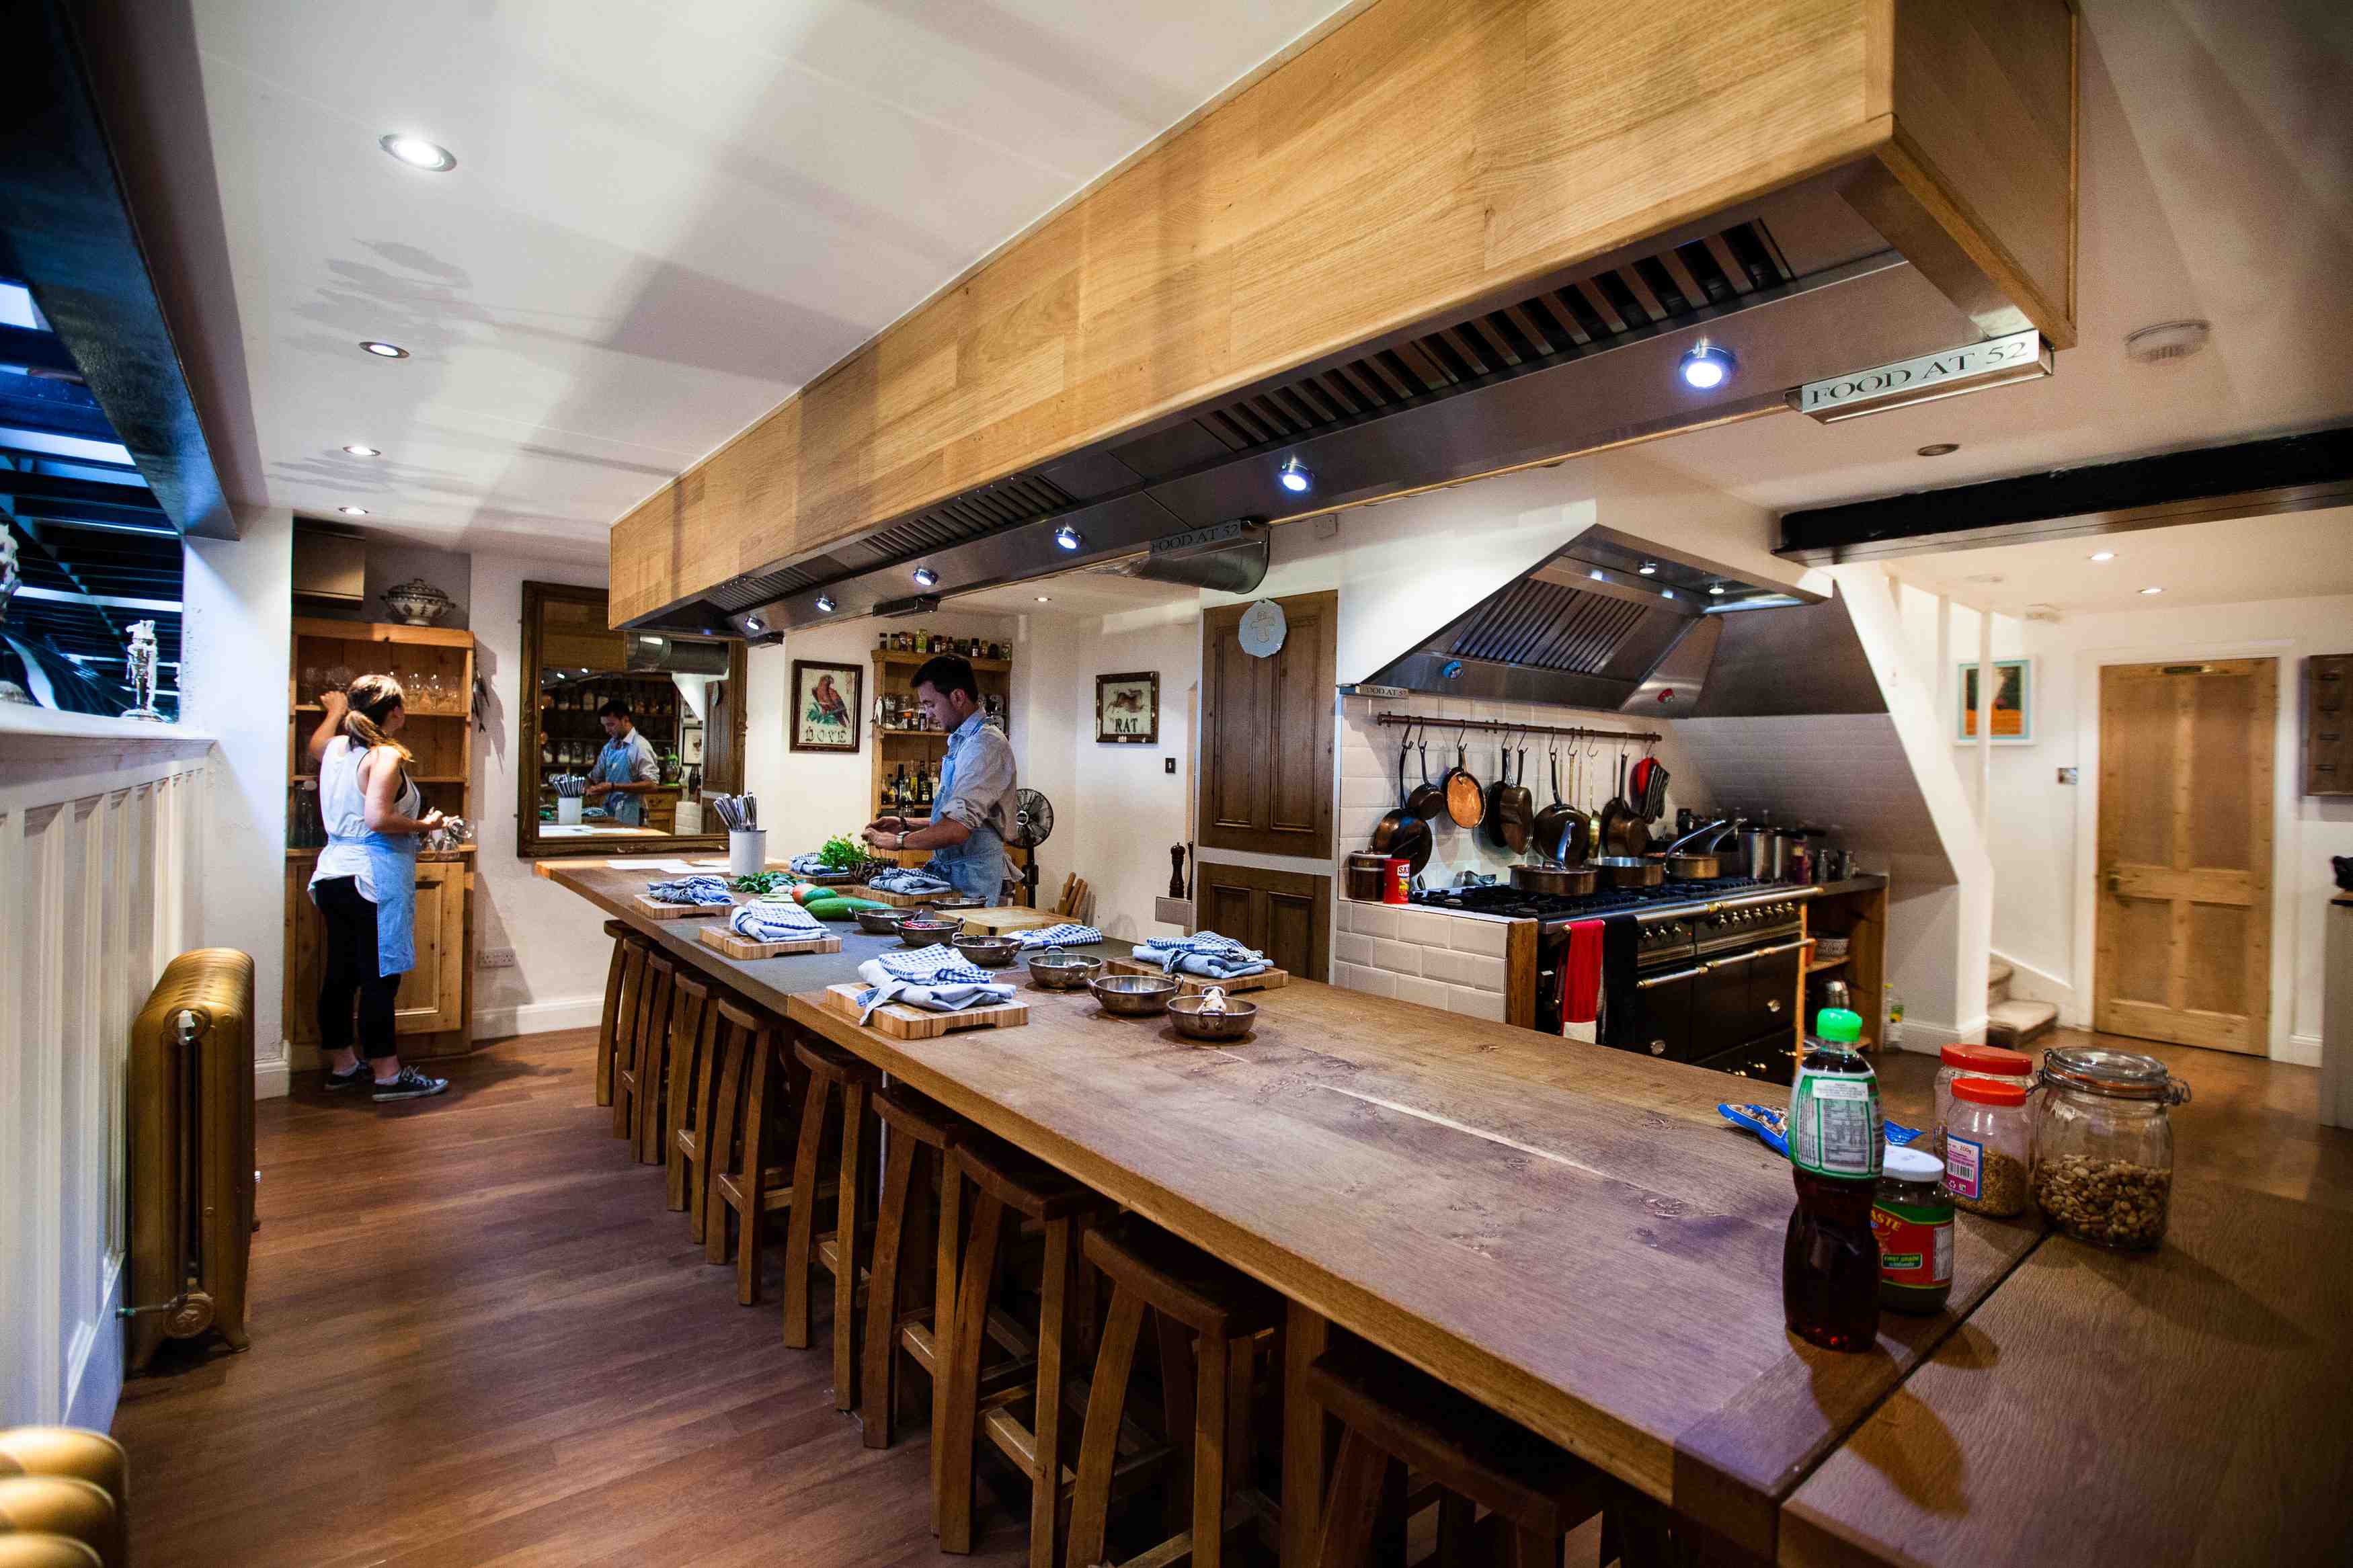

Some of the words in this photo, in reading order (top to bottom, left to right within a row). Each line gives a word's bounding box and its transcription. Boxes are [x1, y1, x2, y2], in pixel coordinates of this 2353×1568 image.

[1810, 369, 1912, 405] FOOD
[1922, 352, 1975, 379] AT
[1985, 341, 2029, 364] 52
[1152, 534, 1193, 552] FOOD
[1197, 529, 1218, 544] AT
[1225, 524, 1238, 537] 52
[1386, 688, 1398, 696] AT
[1115, 718, 1138, 733] RAT
